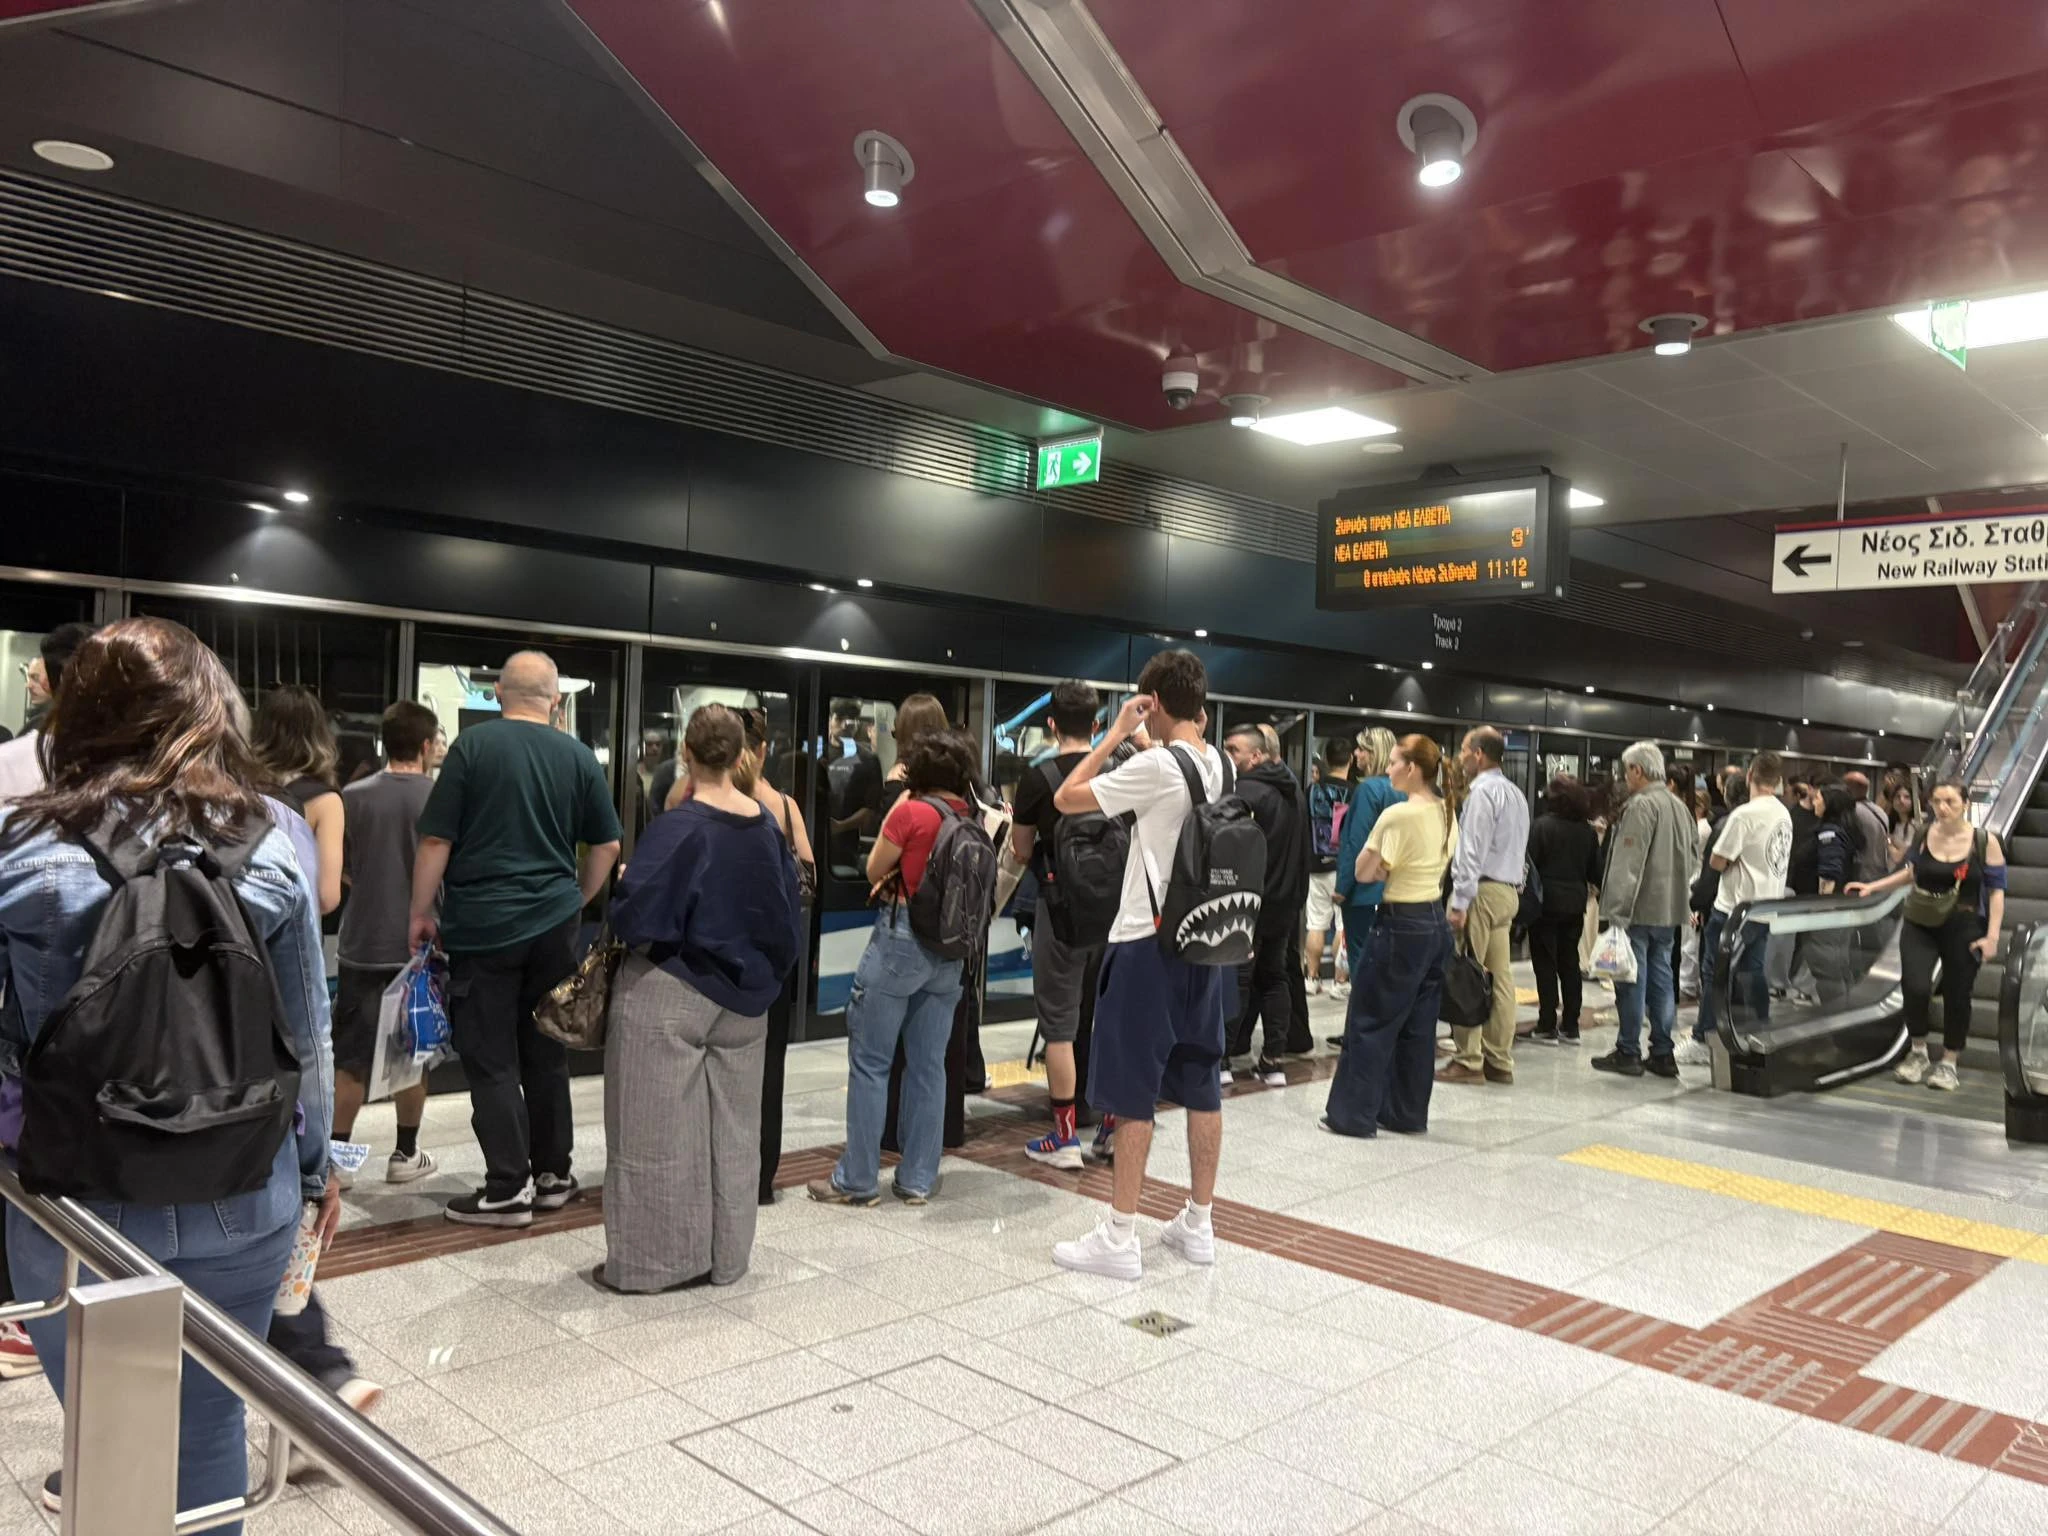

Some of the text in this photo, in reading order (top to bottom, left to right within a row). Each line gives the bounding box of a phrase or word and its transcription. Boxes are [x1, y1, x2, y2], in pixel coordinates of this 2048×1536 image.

[1335, 514, 1367, 536] Συρμός
[1369, 515, 1392, 532] προς
[1393, 508, 1411, 529] ΝΕΑ
[1861, 519, 2048, 557] Νέος Σιδ. Σταθ
[1334, 543, 1351, 563] ΝΕΑ
[1487, 557, 1527, 579] 11:12
[1877, 561, 1917, 581] New
[1923, 557, 1998, 579] Railway
[1434, 633, 1453, 650] Track
